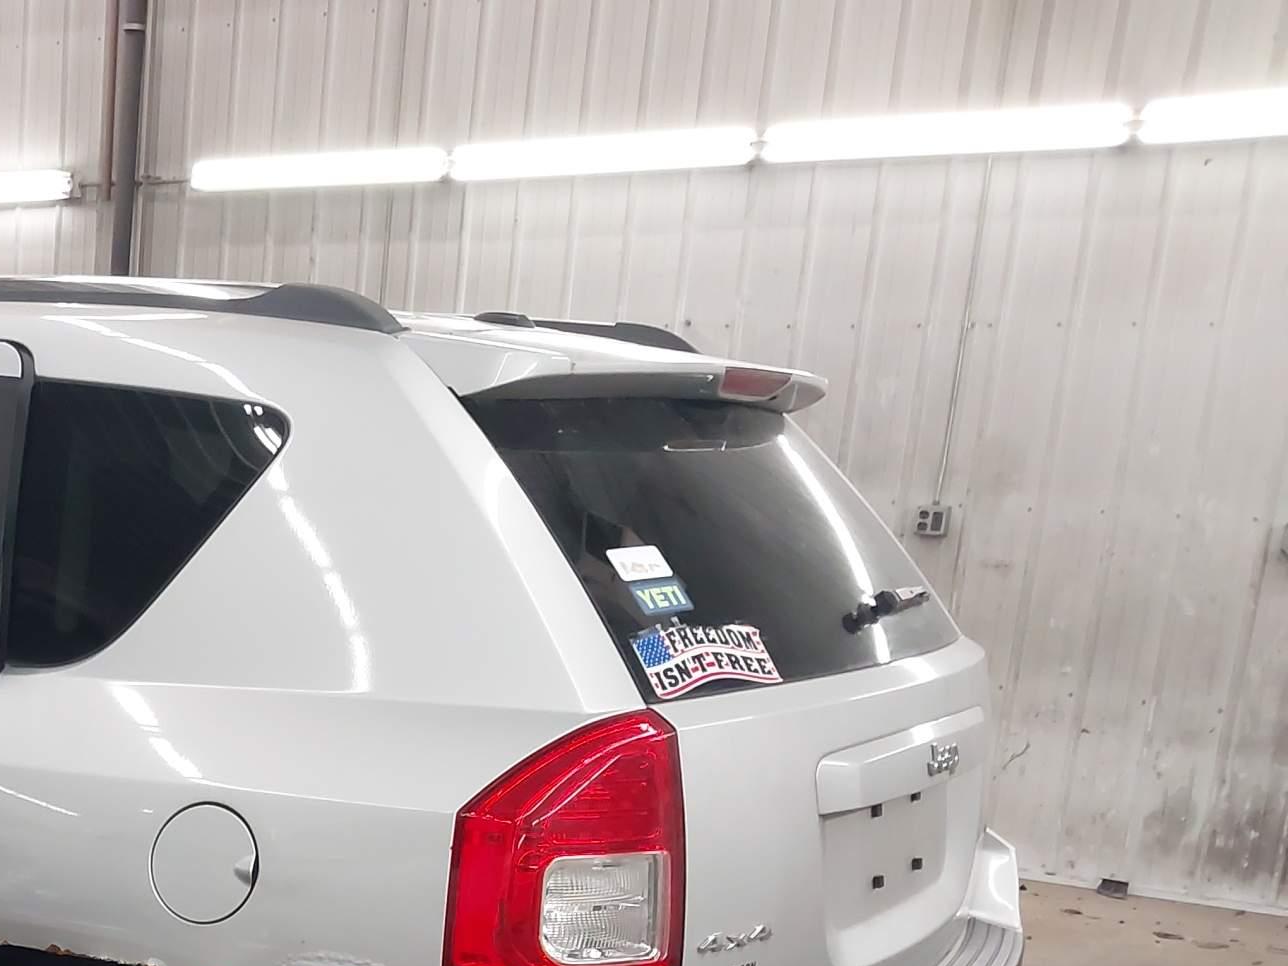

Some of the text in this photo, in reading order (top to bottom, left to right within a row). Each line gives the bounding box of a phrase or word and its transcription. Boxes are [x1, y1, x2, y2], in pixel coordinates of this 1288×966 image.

[636, 586, 687, 610] YETI
[665, 627, 759, 654] FREEDOM
[711, 651, 773, 676] FREE
